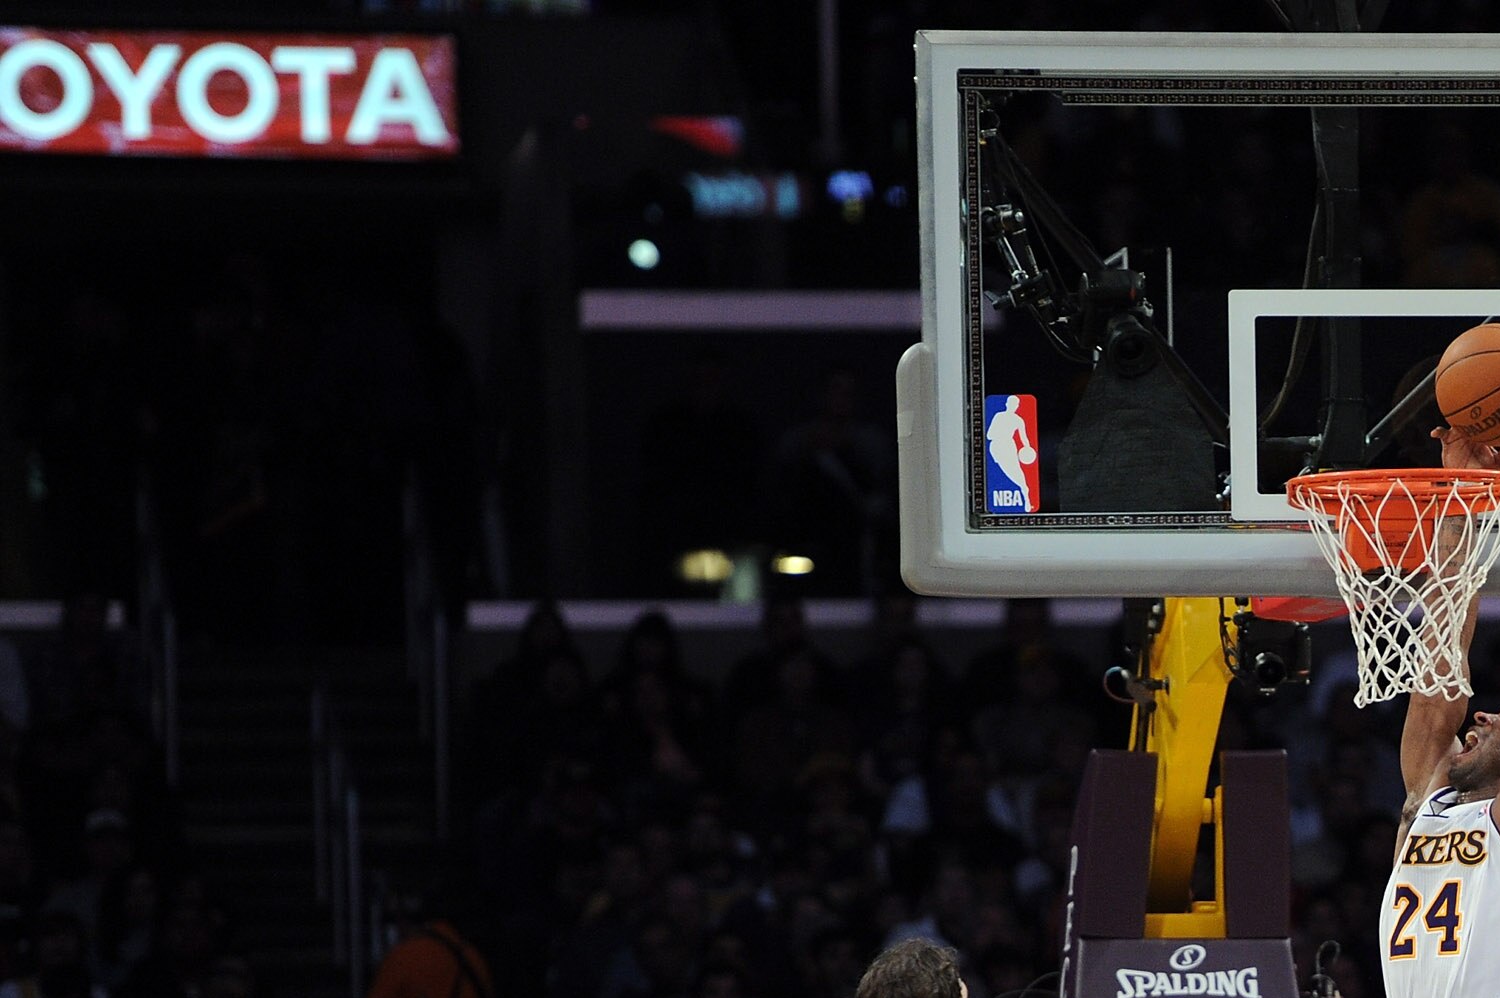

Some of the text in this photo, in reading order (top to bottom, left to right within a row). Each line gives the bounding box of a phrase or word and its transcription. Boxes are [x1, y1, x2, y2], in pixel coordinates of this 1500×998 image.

[0, 41, 449, 144] OYOTA
[993, 490, 1023, 506] NBA
[1401, 830, 1487, 864] KERS
[1389, 878, 1463, 960] 24
